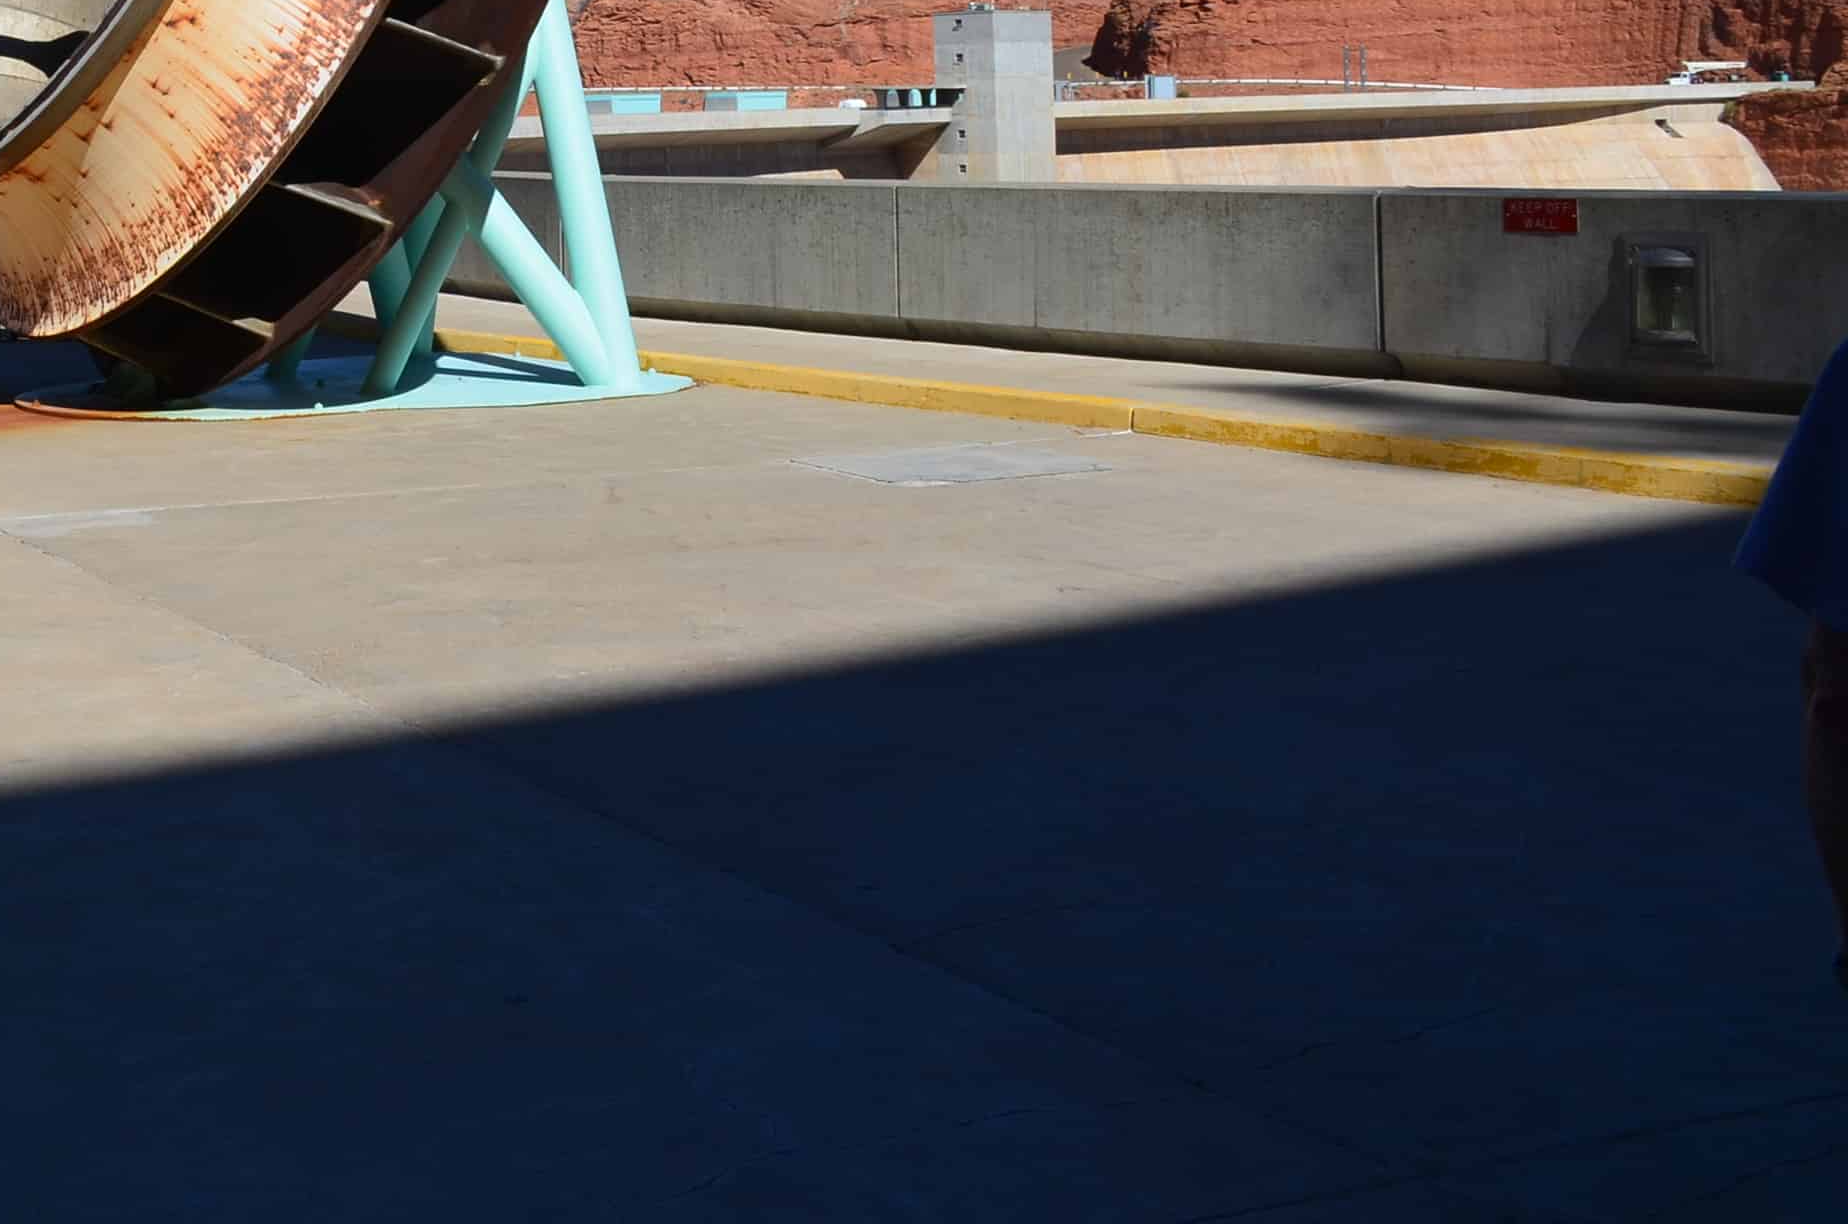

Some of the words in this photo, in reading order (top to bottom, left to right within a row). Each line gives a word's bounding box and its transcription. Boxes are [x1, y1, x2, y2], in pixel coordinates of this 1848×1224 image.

[1510, 200, 1542, 214] KEEP
[1545, 200, 1569, 215] OFF
[1523, 216, 1560, 230] WALL
